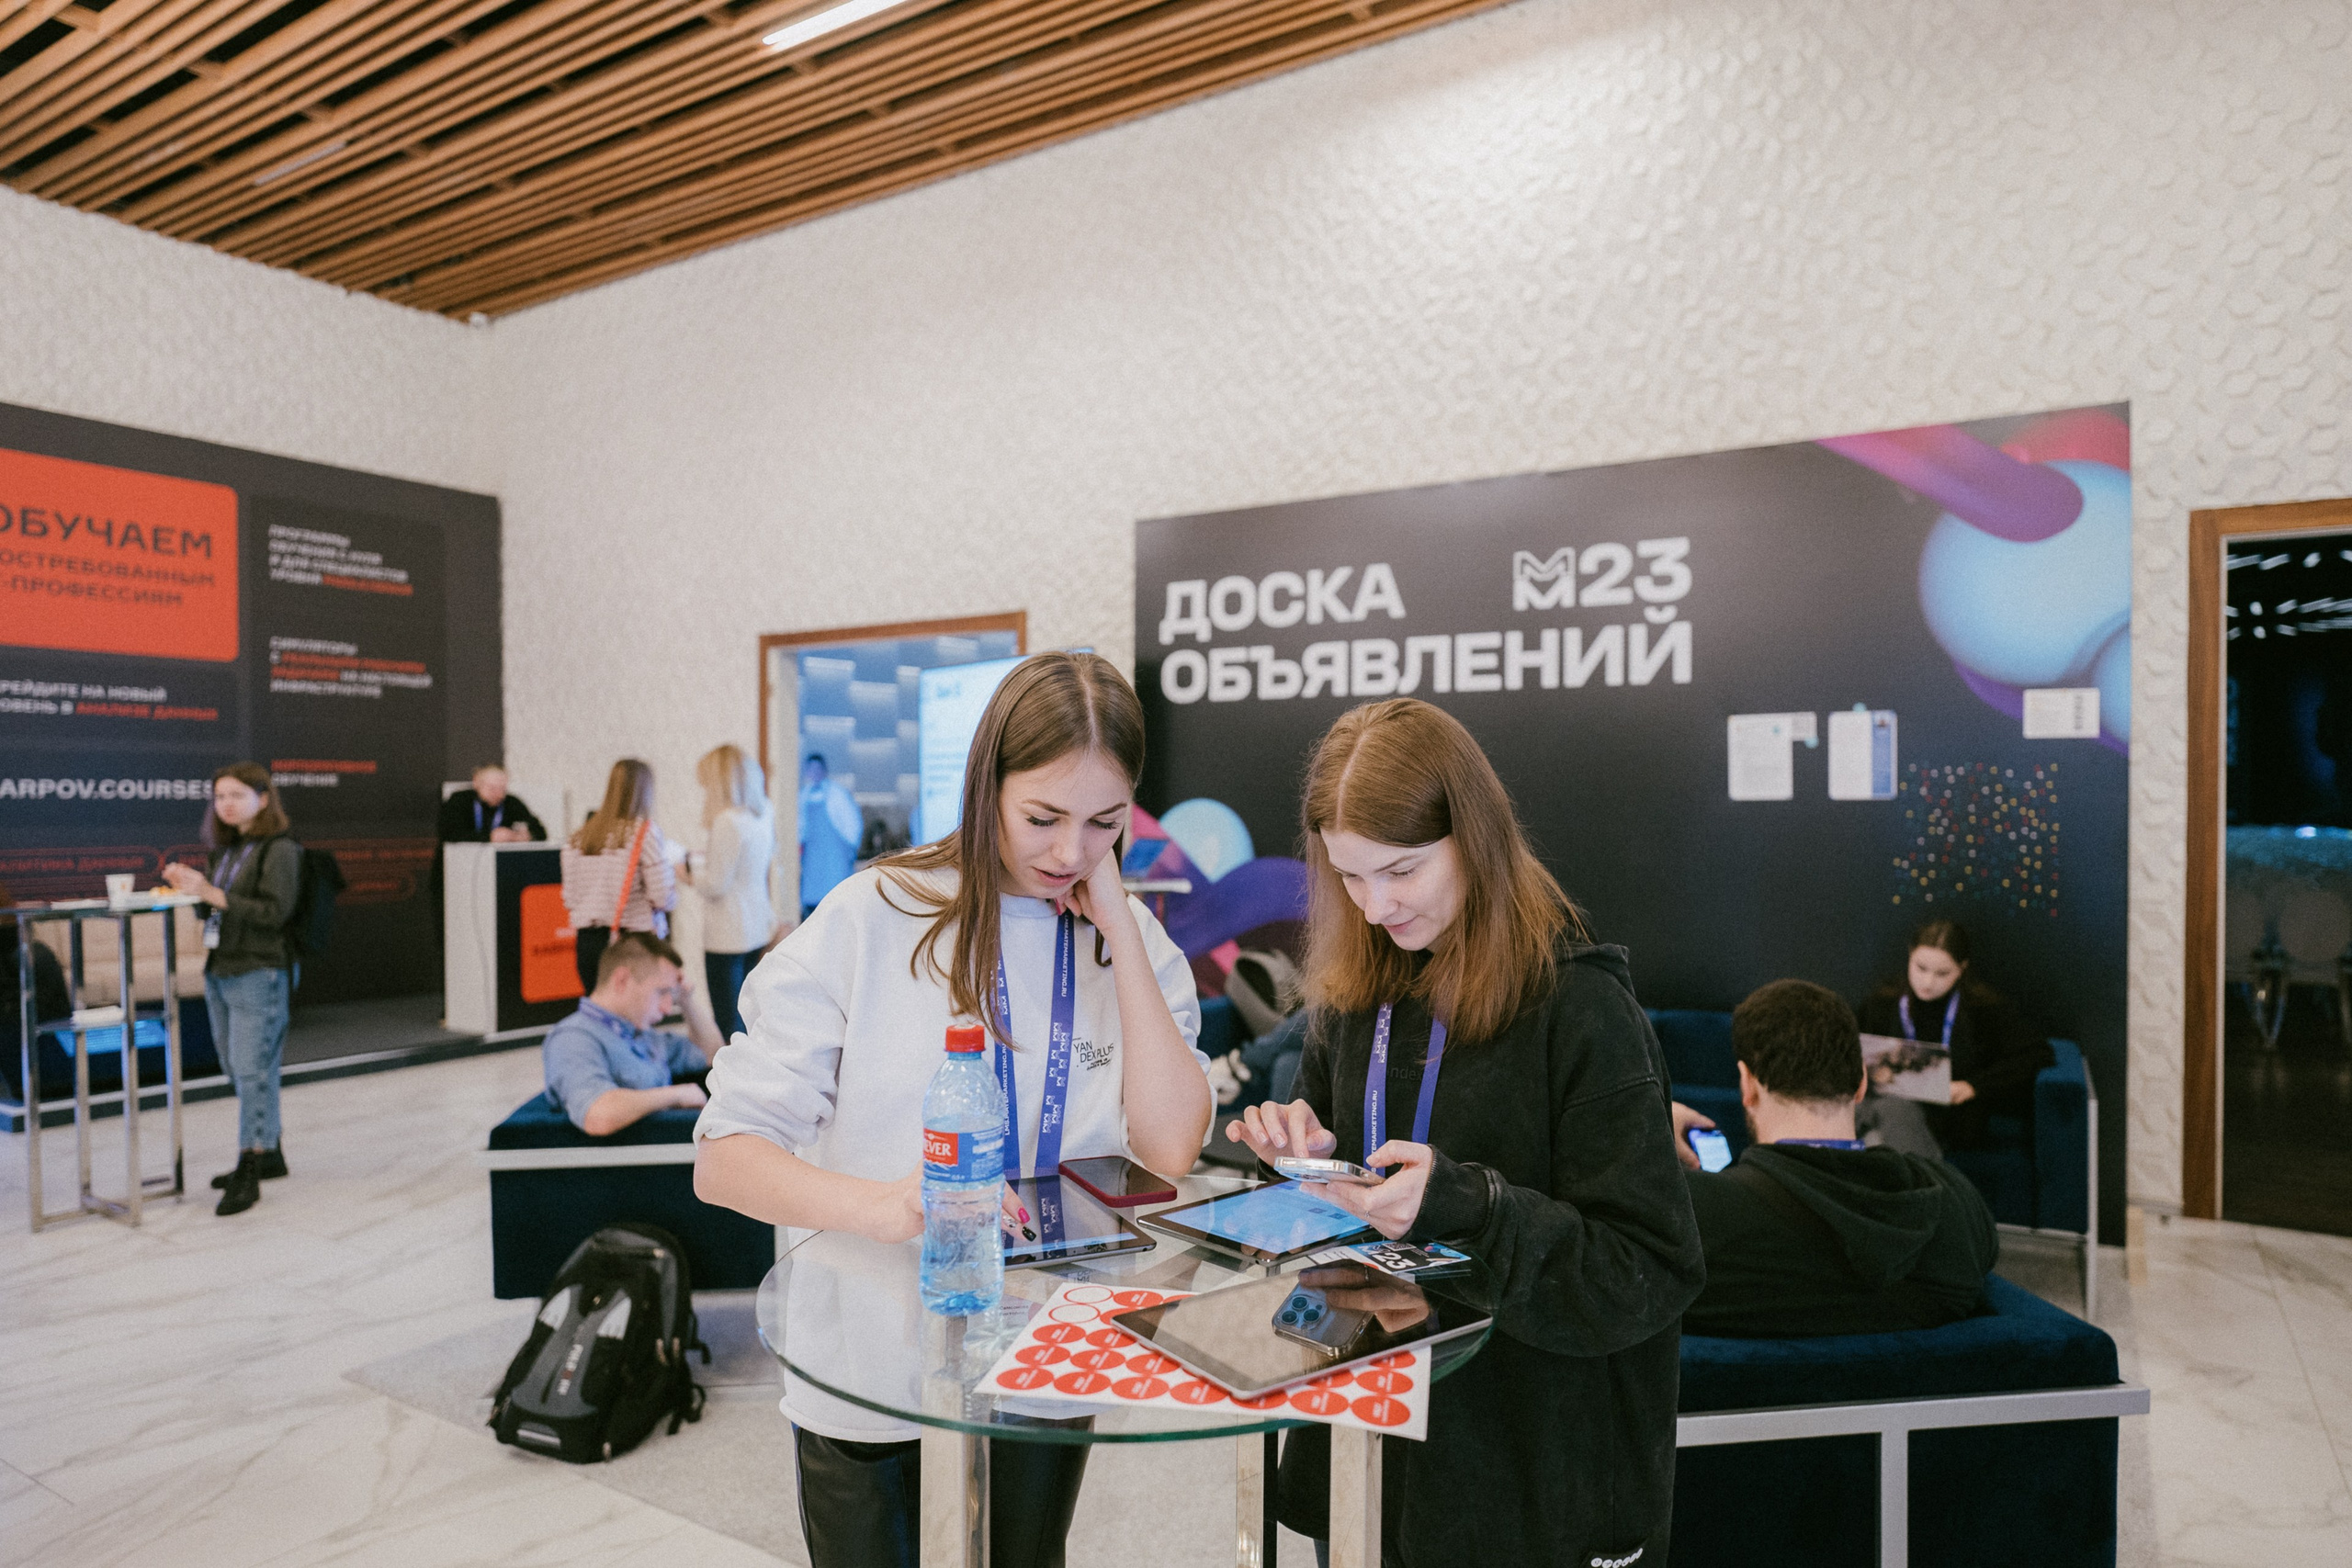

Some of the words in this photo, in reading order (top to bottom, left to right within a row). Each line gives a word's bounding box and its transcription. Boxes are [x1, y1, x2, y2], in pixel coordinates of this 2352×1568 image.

[1159, 562, 1407, 645] ДОСКА
[1159, 604, 1693, 705] ОБЪЯВЛЕНИЙ
[1073, 1040, 1093, 1054] YAN
